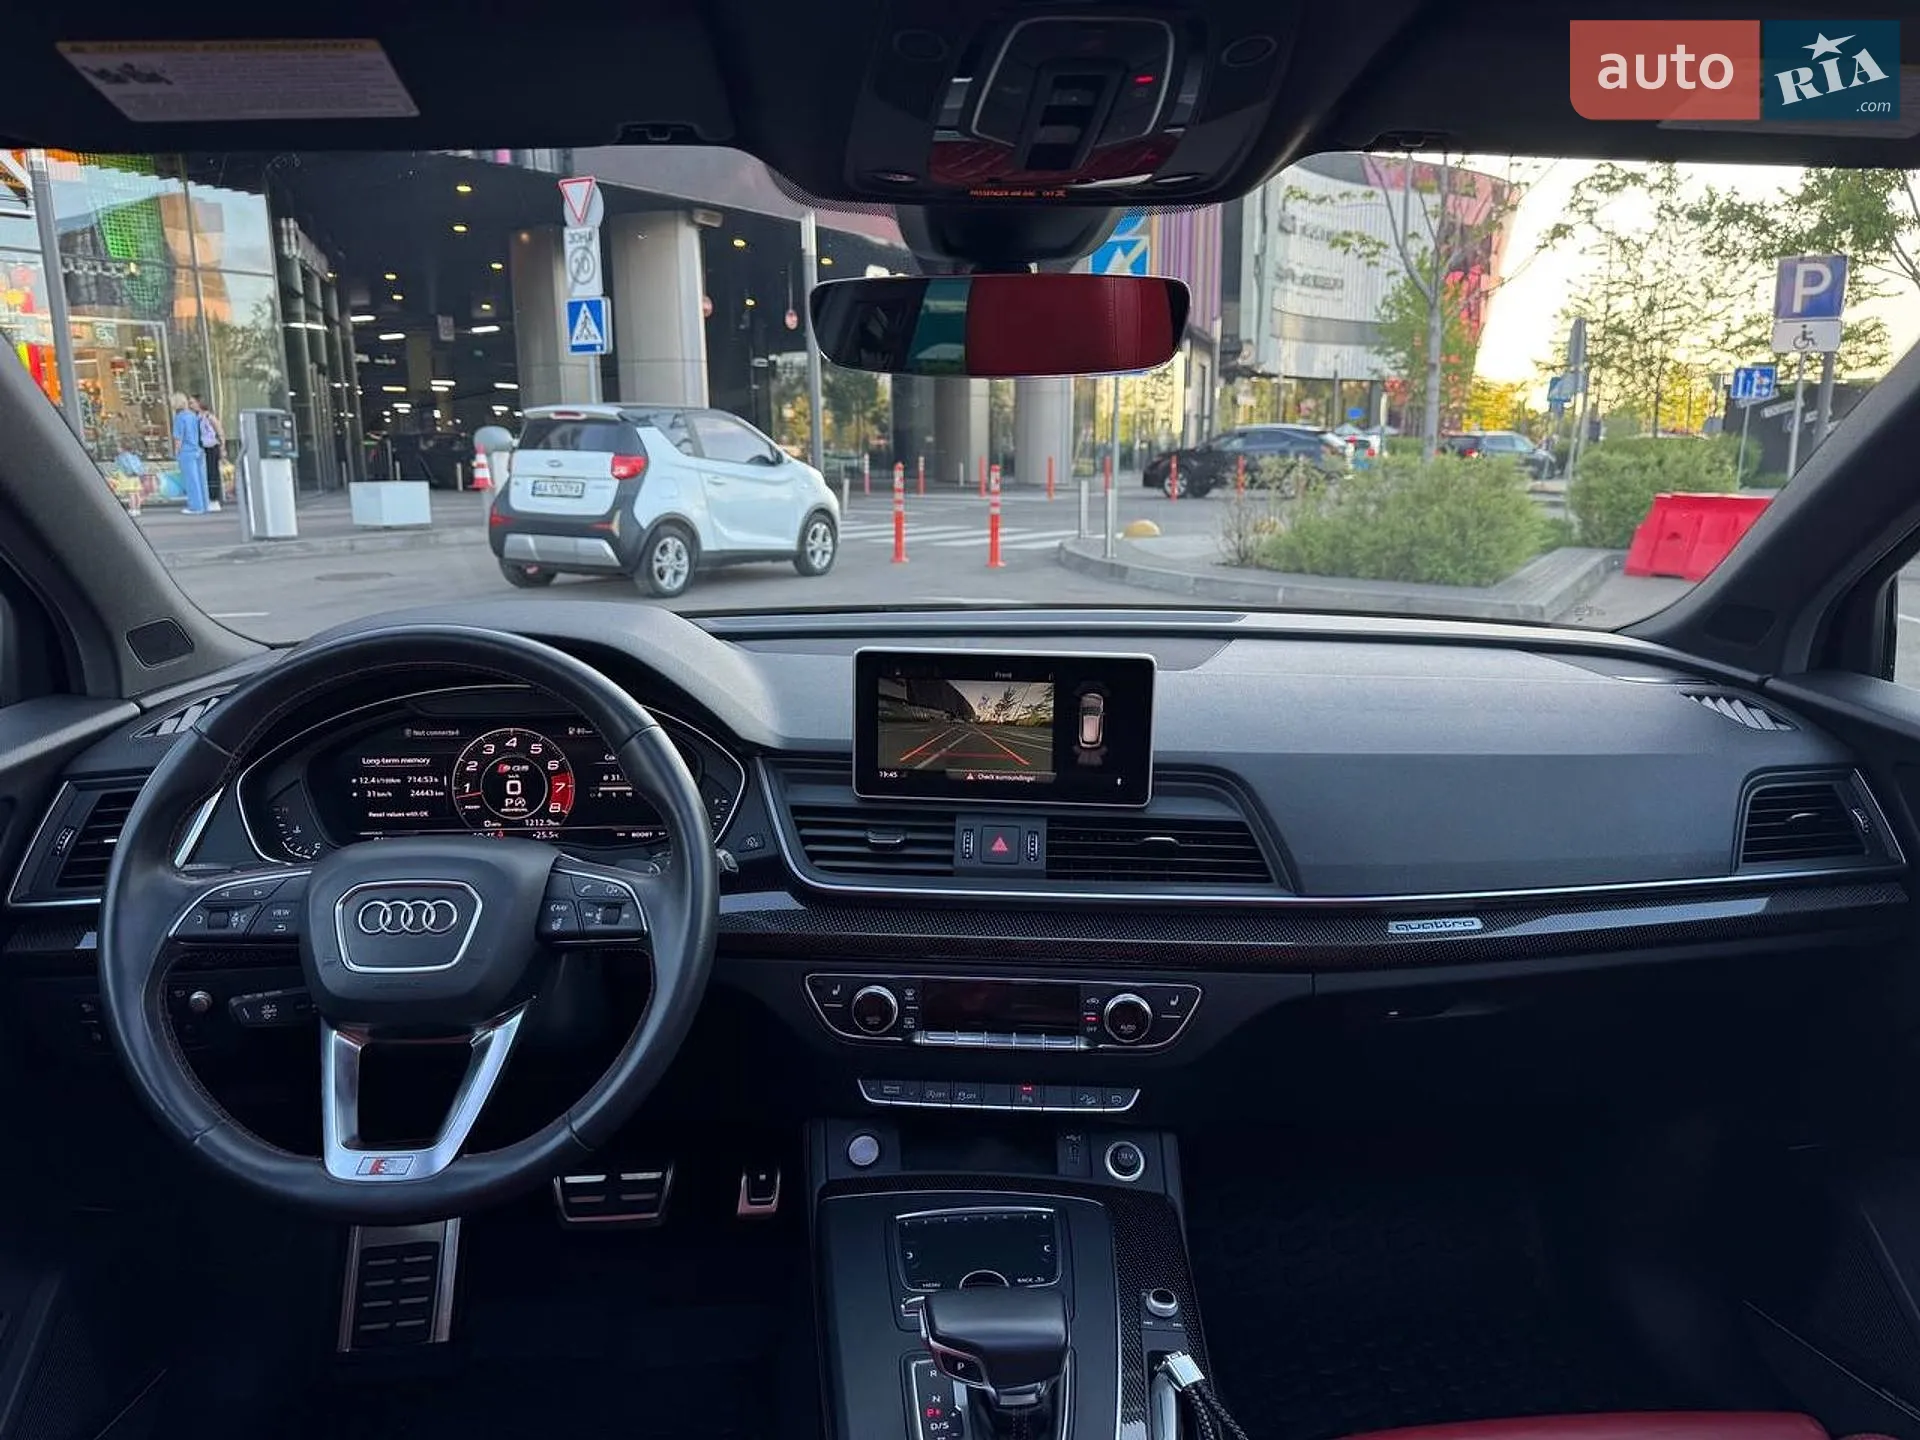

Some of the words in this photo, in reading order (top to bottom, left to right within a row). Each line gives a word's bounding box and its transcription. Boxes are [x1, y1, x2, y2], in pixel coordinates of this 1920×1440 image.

[1792, 262, 1832, 314] P
[505, 737, 518, 748] 4
[482, 743, 495, 755] 3
[530, 743, 543, 754] 5
[361, 757, 401, 766] Long-term
[400, 757, 431, 765] memory
[466, 760, 479, 771] 2
[547, 760, 560, 770] 6
[463, 783, 471, 793] 1
[505, 780, 522, 796] 0
[555, 783, 566, 793] 7
[504, 798, 513, 807] P
[549, 802, 561, 813] 8
[1395, 920, 1475, 931] quattro
[956, 1361, 965, 1371] P
[929, 1370, 938, 1378] R
[931, 1395, 942, 1403] N
